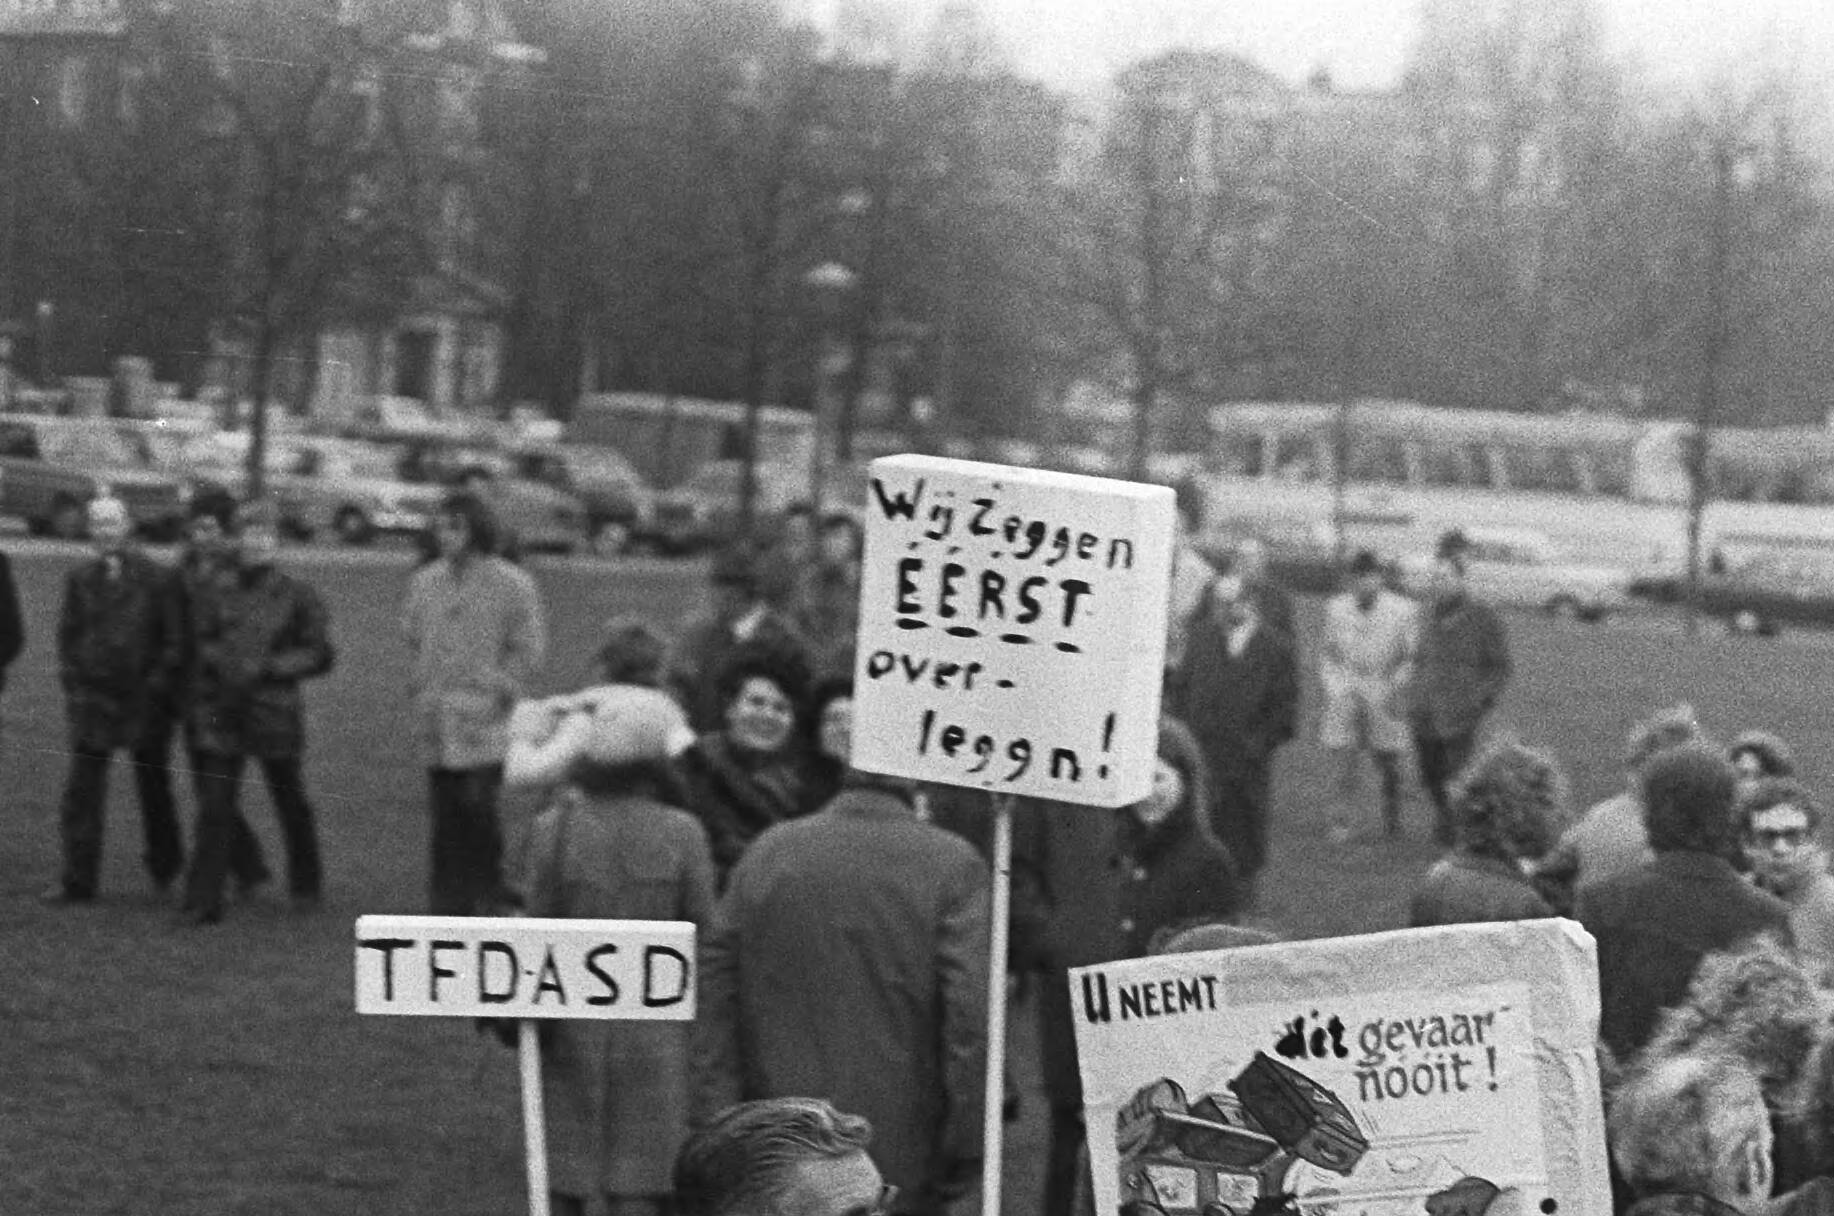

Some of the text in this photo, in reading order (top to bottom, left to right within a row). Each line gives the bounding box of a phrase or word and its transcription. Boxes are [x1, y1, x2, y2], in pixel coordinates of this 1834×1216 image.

[896, 556, 1094, 628] EERST
[1081, 971, 1218, 1024] U NEEMT
[1274, 1009, 1349, 1061] dit
